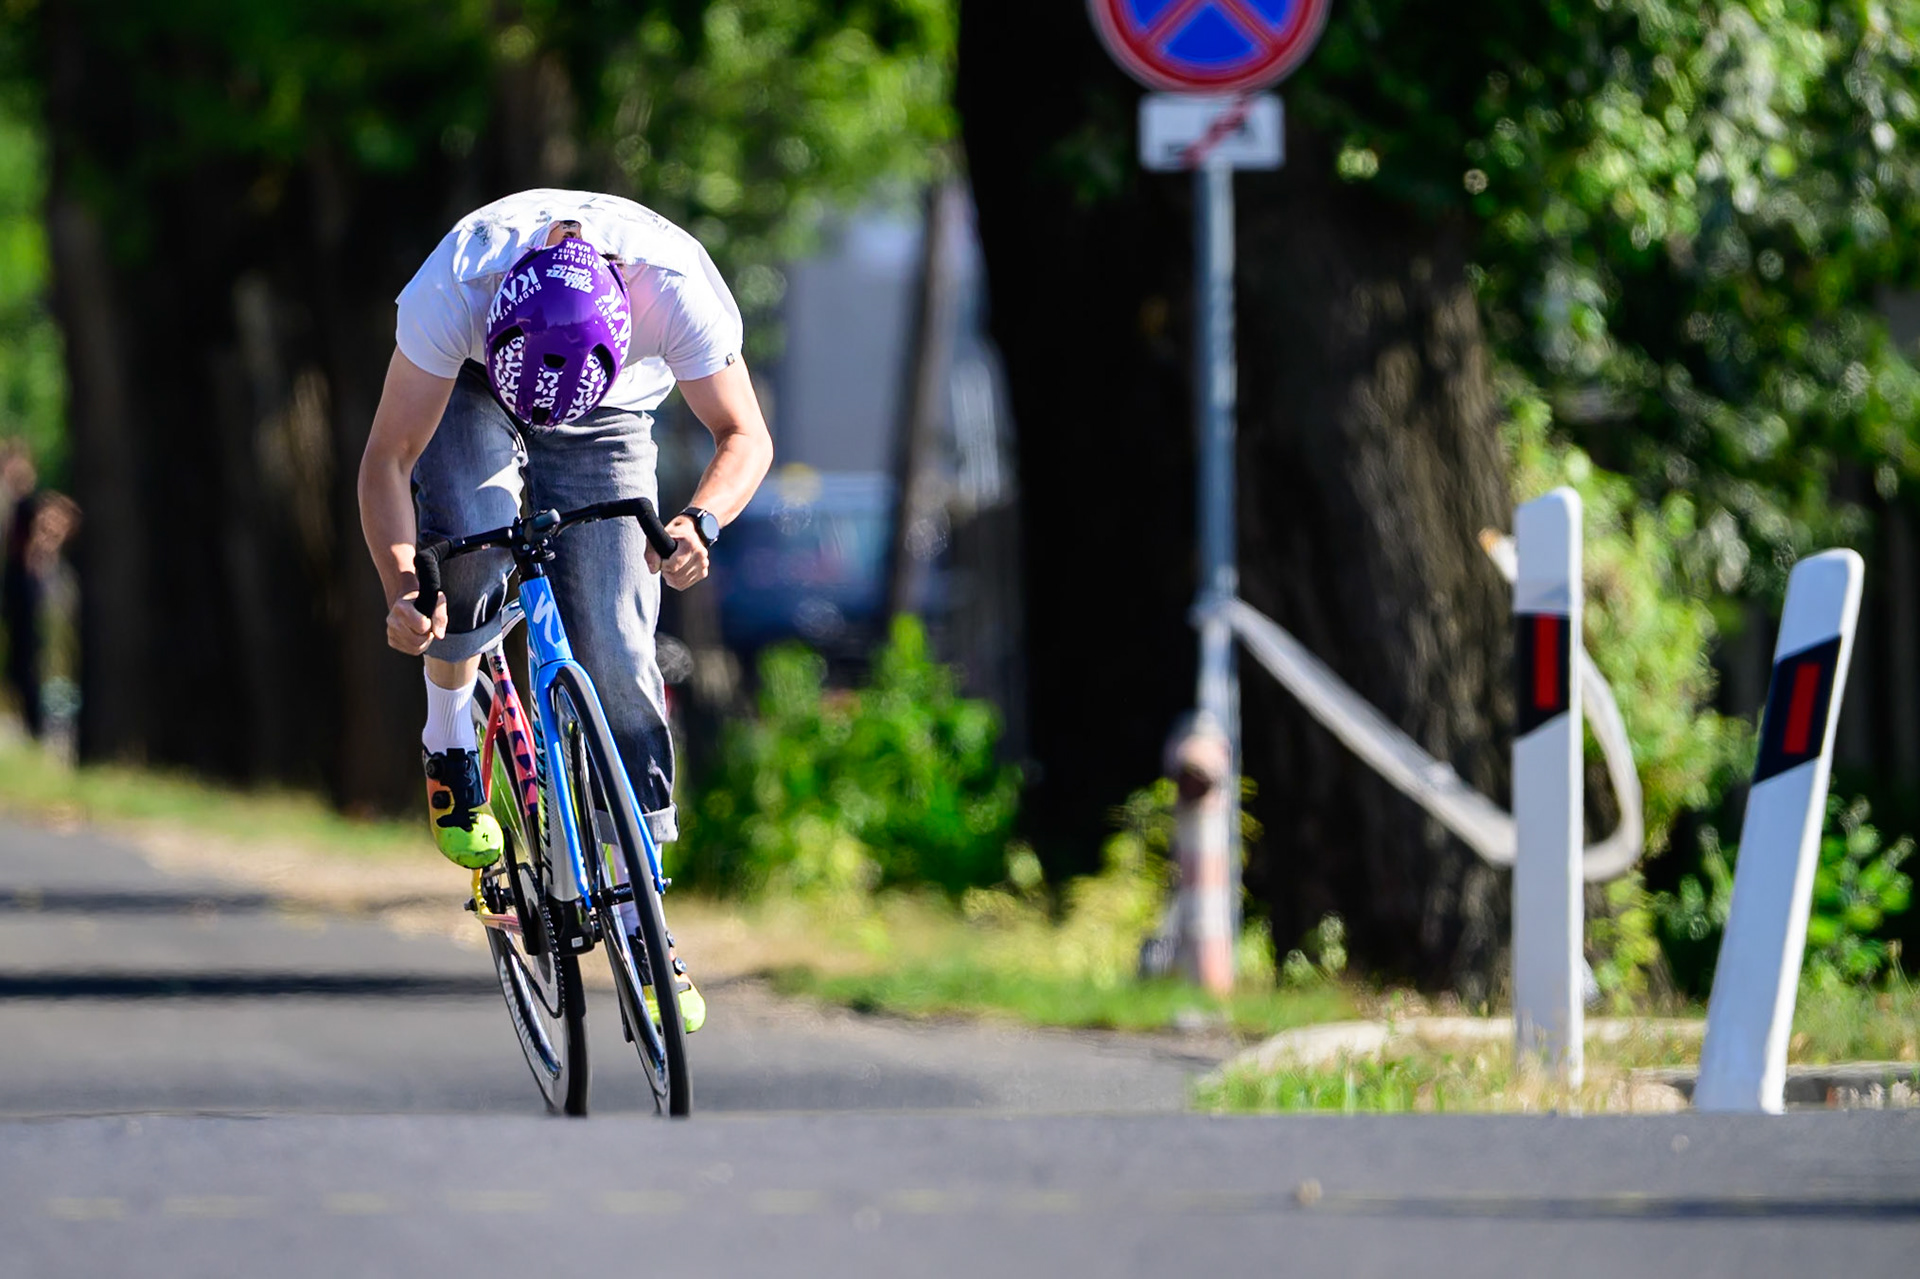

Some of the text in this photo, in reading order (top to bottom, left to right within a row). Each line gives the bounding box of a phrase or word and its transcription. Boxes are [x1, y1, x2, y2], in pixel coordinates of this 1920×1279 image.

[566, 241, 591, 253] KASK
[552, 253, 598, 270] RADPLATZ
[499, 283, 542, 320] RADPLATZ
[594, 297, 621, 348] RADPLATZ
